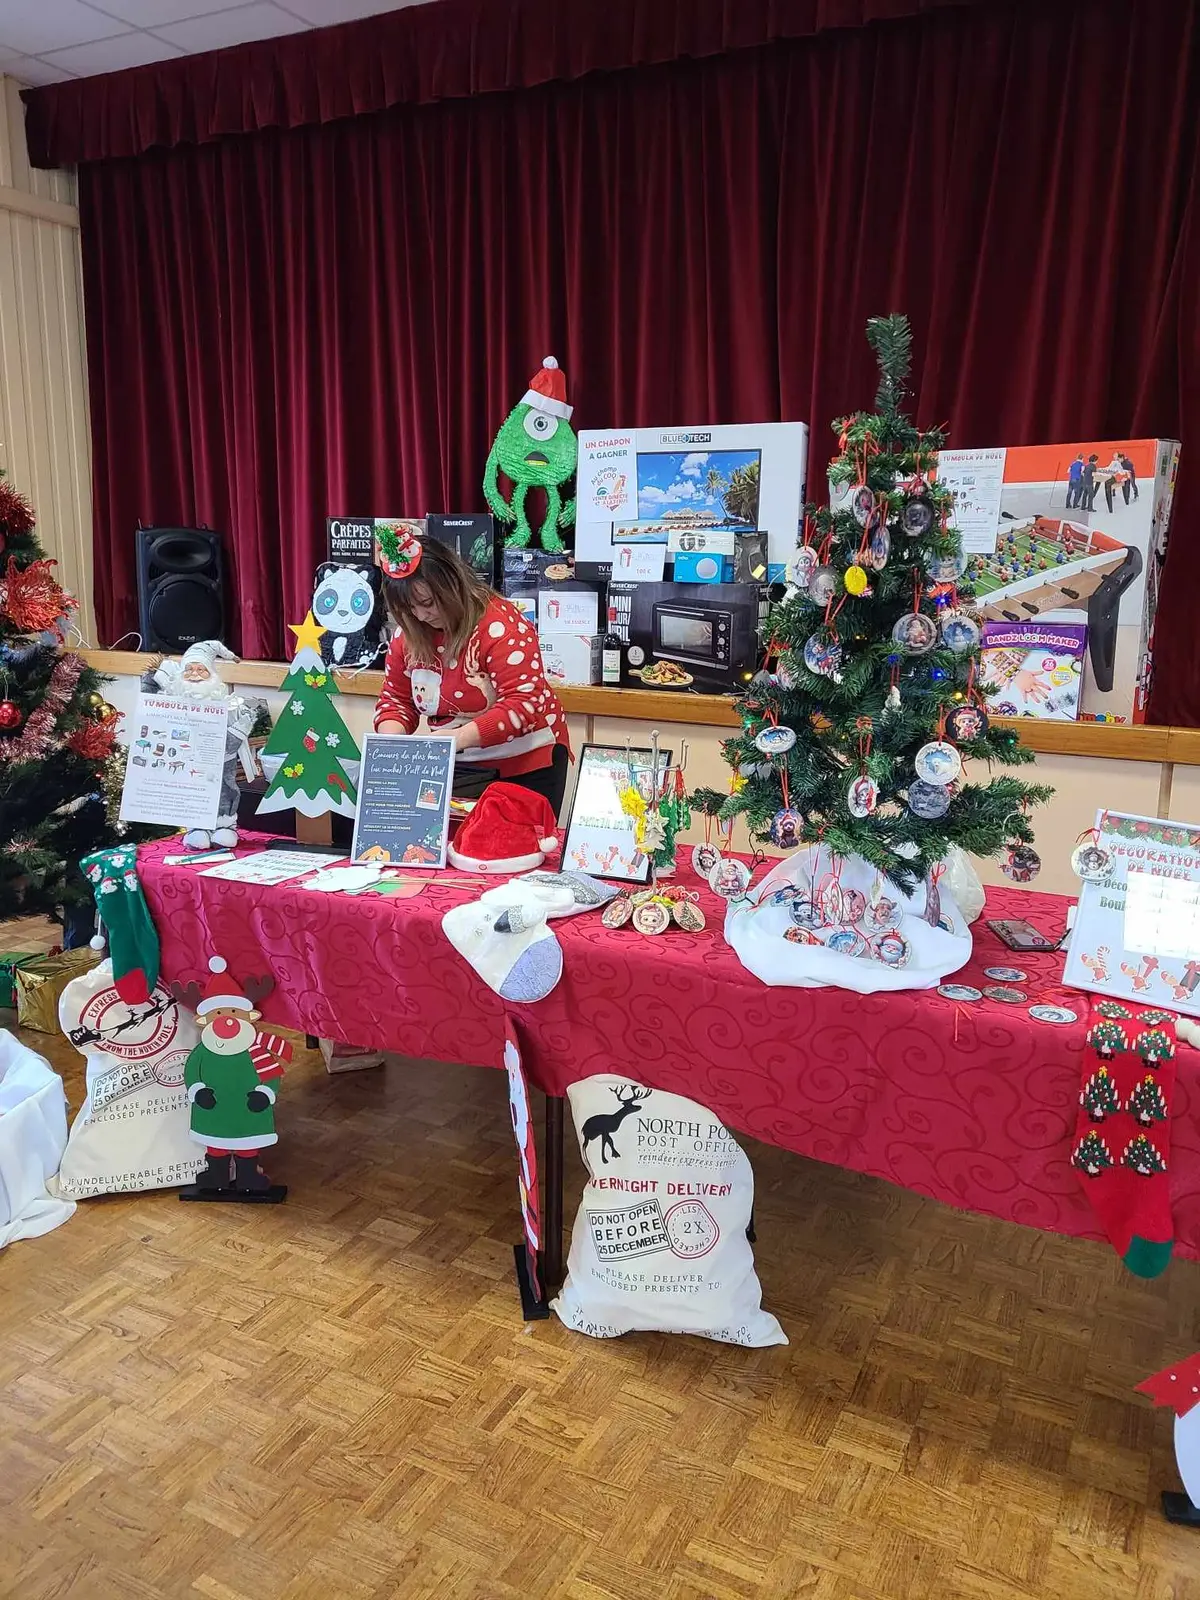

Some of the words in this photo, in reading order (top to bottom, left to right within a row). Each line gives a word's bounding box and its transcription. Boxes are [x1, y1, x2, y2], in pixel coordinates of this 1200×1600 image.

[598, 437, 631, 448] CHAPON
[689, 434, 710, 442] TECH
[596, 449, 628, 459] GAGNER
[330, 520, 372, 538] CRÊPES
[331, 538, 371, 552] PARFAITES
[609, 595, 632, 612] MINI
[987, 634, 1018, 645] BANDZ
[1019, 633, 1047, 643] LOOM
[1047, 635, 1080, 648] MAKER
[1080, 711, 1127, 723] moby
[372, 747, 400, 760] Concours
[411, 750, 426, 763] plus
[403, 763, 421, 776] Pull
[88, 991, 119, 1018] EXPRESS
[101, 1042, 123, 1055] FROM
[124, 1047, 138, 1056] THE
[138, 1041, 161, 1056] NORTH
[158, 1024, 173, 1043] POLE
[95, 1068, 150, 1097] BEFORE
[96, 1078, 106, 1088] DO
[108, 1070, 121, 1082] NOT
[104, 1075, 153, 1103] DECEMBER
[103, 1102, 140, 1113] PLEASE
[147, 1093, 189, 1107] DELIVER
[84, 1111, 135, 1126] ENCLOSED
[140, 1101, 189, 1116] PRESENTS
[636, 1117, 702, 1138] NORTH
[637, 1135, 679, 1148] POST
[638, 1152, 678, 1163] reindeer
[679, 1155, 713, 1167] express
[64, 1185, 100, 1195] SANTA
[156, 1169, 198, 1184] NORTH
[75, 1167, 163, 1186] UNDELIVERABLE
[588, 1177, 659, 1193] VERNIGHT
[667, 1183, 733, 1197] DELIVERY
[591, 1215, 604, 1226] DO
[606, 1213, 626, 1225] NOT
[628, 1204, 657, 1221] OPEN
[595, 1218, 662, 1242] BEFORE
[673, 1237, 711, 1252] CHECKED
[591, 1267, 638, 1292] ENCLOSED
[644, 1284, 700, 1293] PRESENTS
[605, 1267, 646, 1282] PLEASE
[653, 1274, 704, 1283] DELIVER
